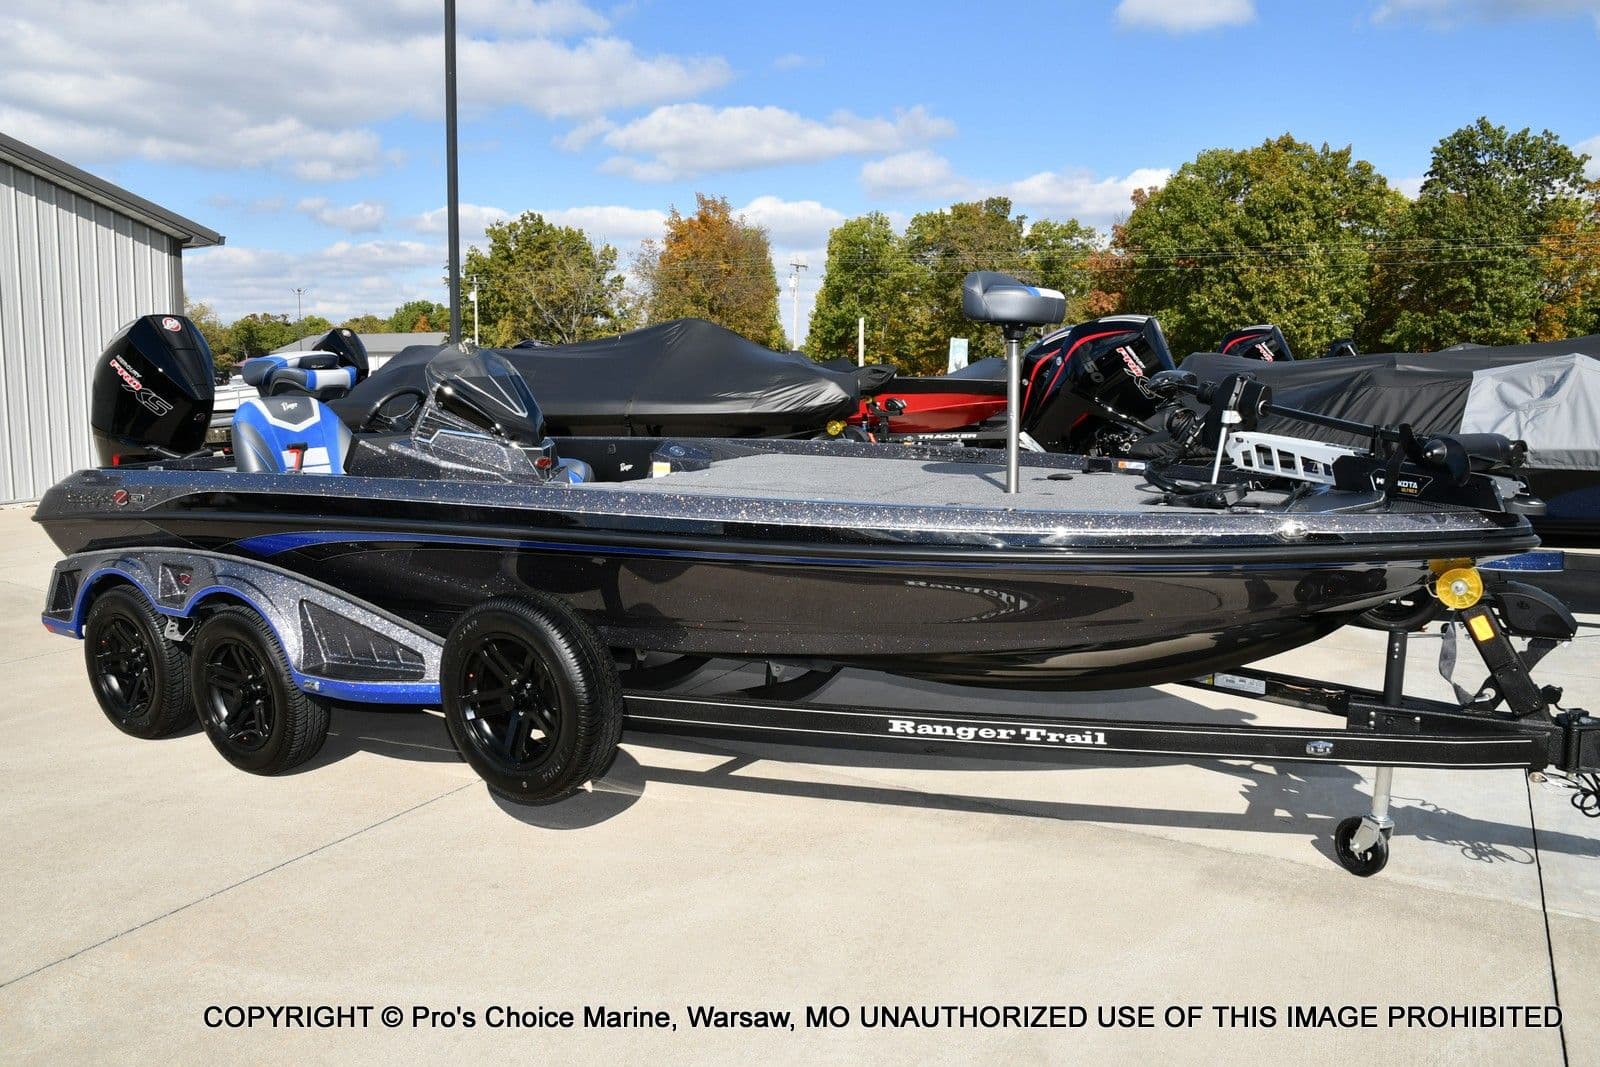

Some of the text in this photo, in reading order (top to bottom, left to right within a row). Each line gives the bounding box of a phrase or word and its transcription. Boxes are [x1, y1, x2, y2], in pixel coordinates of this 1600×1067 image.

[121, 383, 174, 417] XS
[888, 719, 1107, 745] Ranger Trail
